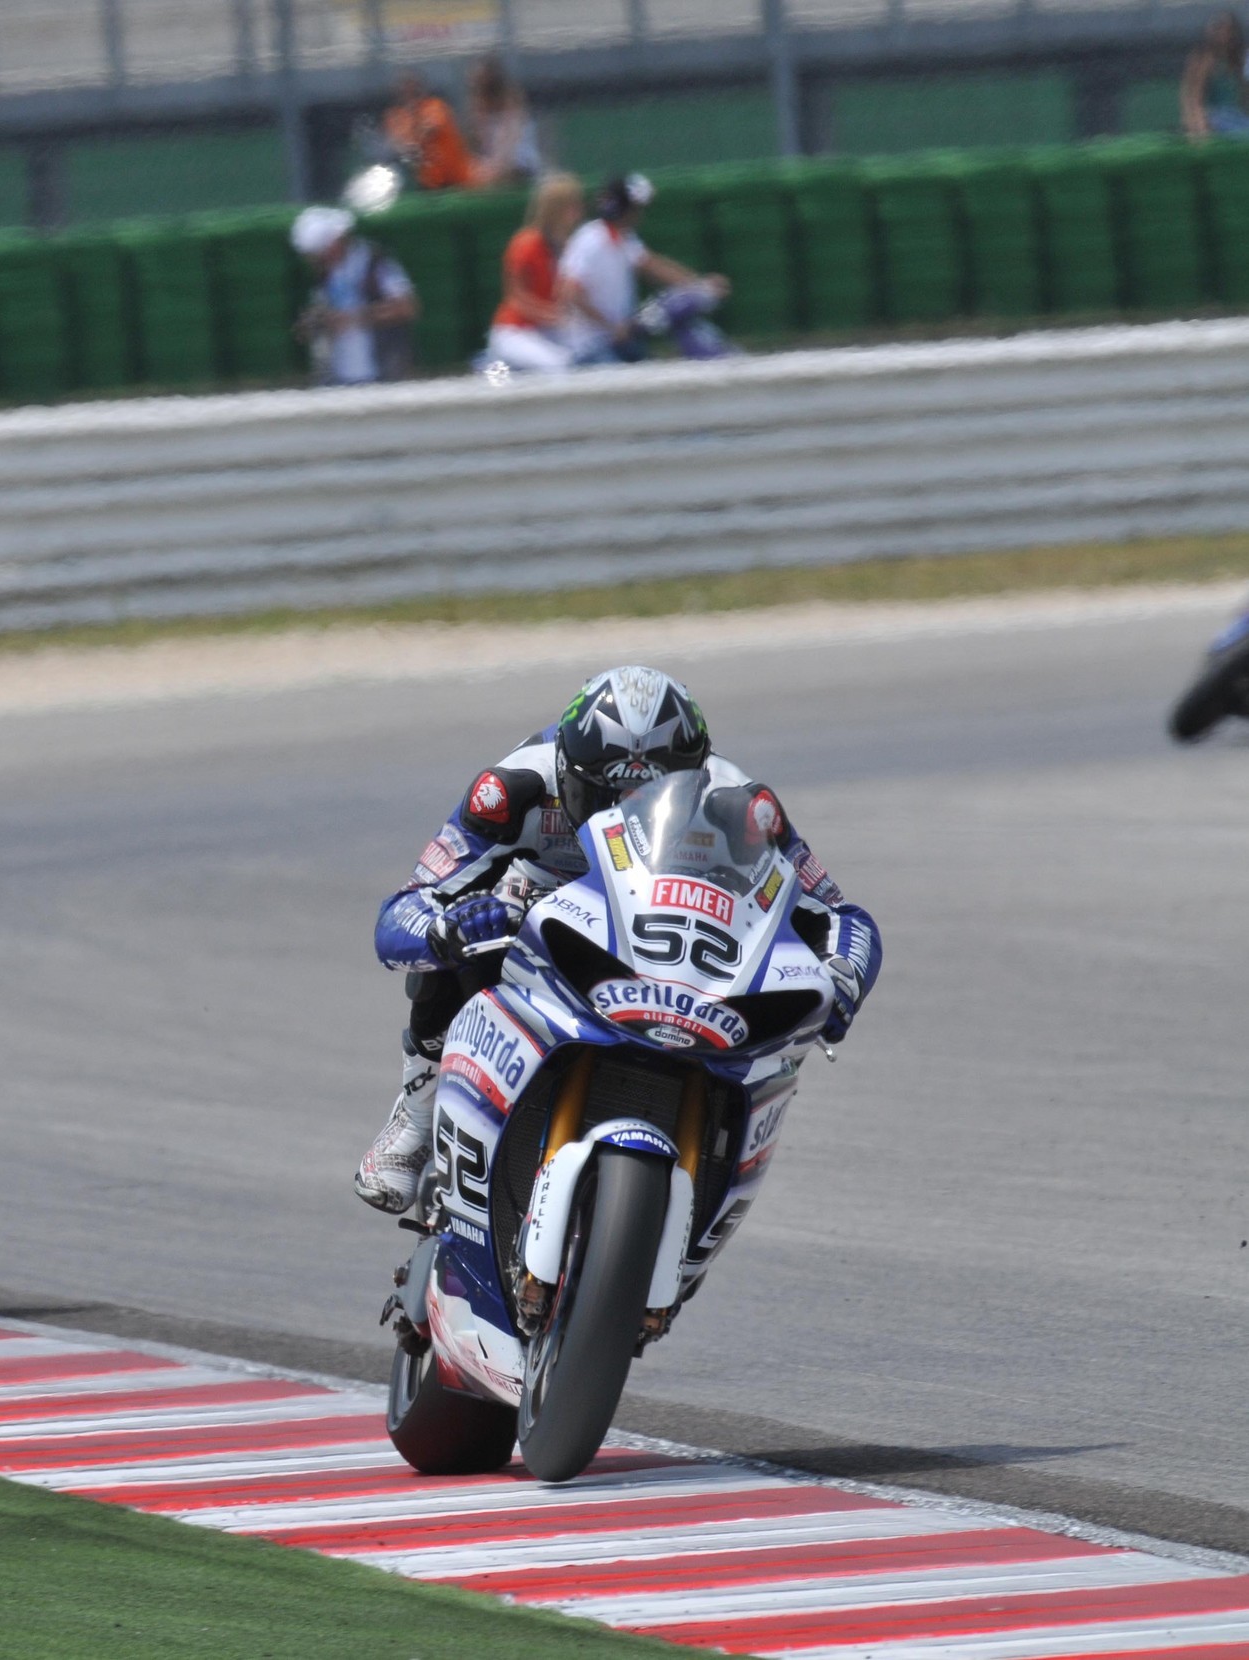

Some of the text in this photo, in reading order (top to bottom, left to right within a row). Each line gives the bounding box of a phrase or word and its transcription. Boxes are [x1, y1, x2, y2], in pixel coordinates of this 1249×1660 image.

[654, 881, 732, 922] FIMER
[630, 913, 743, 983] 52
[595, 982, 747, 1044] sterilgarda
[643, 1012, 703, 1034] alimenti
[447, 998, 526, 1091] terilgarda
[437, 1104, 490, 1214] 52
[611, 1131, 672, 1155] YAMAHA
[450, 1215, 485, 1247] YAMAHA
